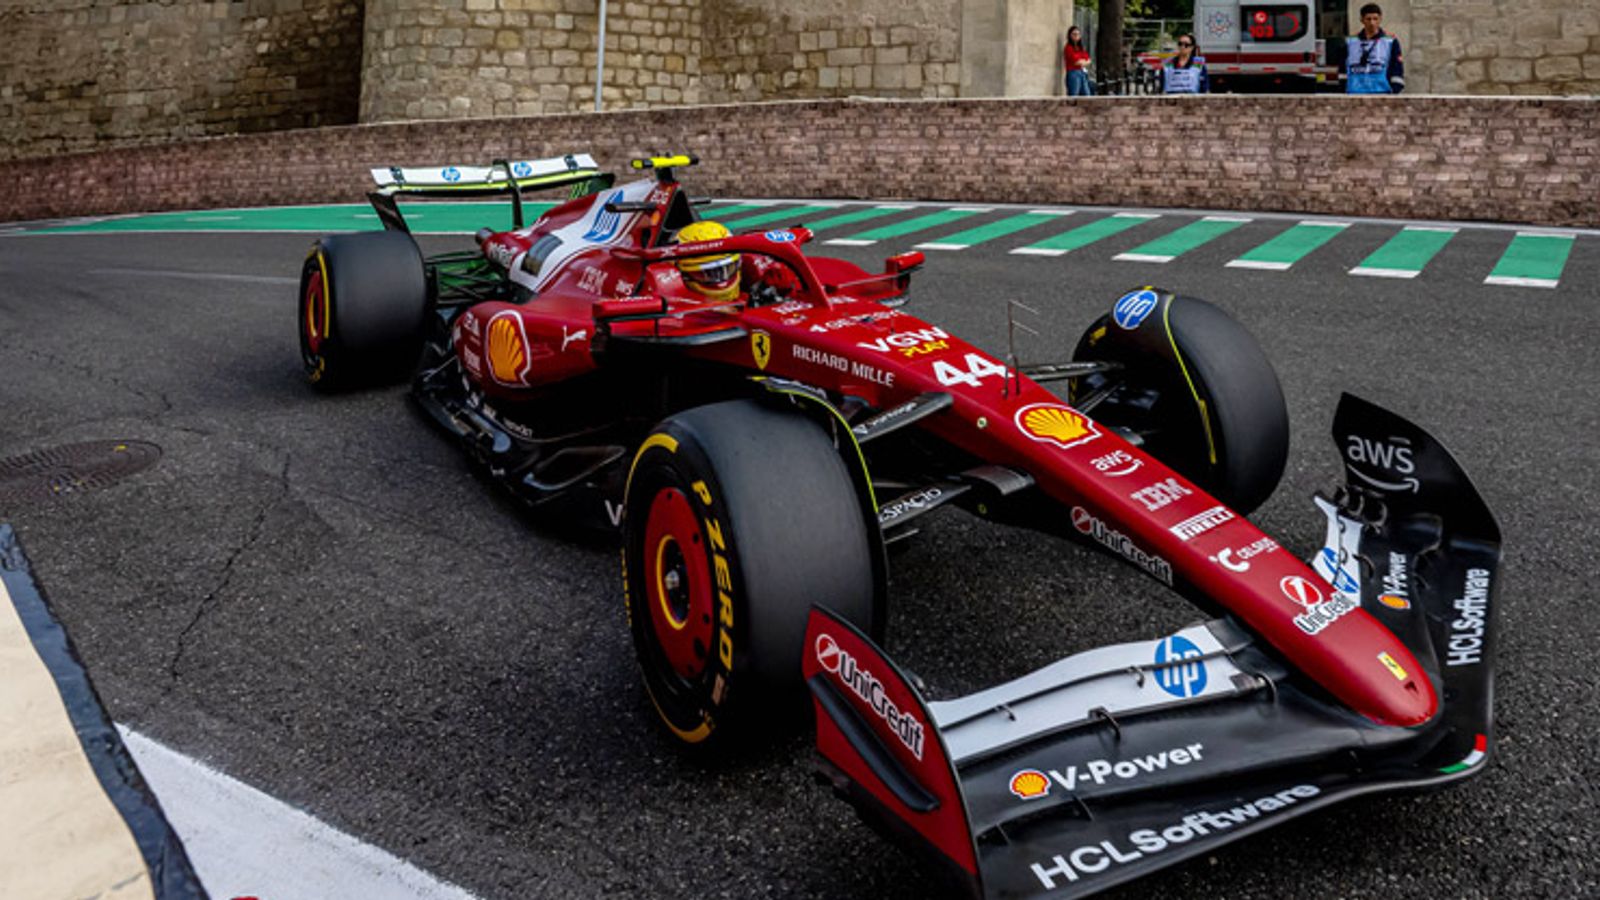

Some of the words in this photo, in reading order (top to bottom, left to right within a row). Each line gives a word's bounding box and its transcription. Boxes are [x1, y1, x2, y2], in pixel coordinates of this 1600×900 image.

[1113, 289, 1158, 330] hp
[856, 326, 949, 352] VGW
[792, 343, 849, 372] RICHARD
[851, 361, 896, 388] MILLE
[932, 352, 1015, 388] 44
[1090, 450, 1138, 474] aws
[1347, 434, 1417, 482] aws
[1130, 477, 1193, 512] IBM
[692, 479, 713, 506] P
[705, 516, 734, 672] ZERO
[1090, 516, 1174, 588] UniCredit
[1293, 591, 1356, 635] UniCredit
[1446, 567, 1491, 667] HCLSoftware
[1154, 635, 1208, 698] hp
[837, 654, 926, 763] UniCredit
[1049, 740, 1204, 792] V-Power
[1031, 781, 1321, 890] HCLSoftware
